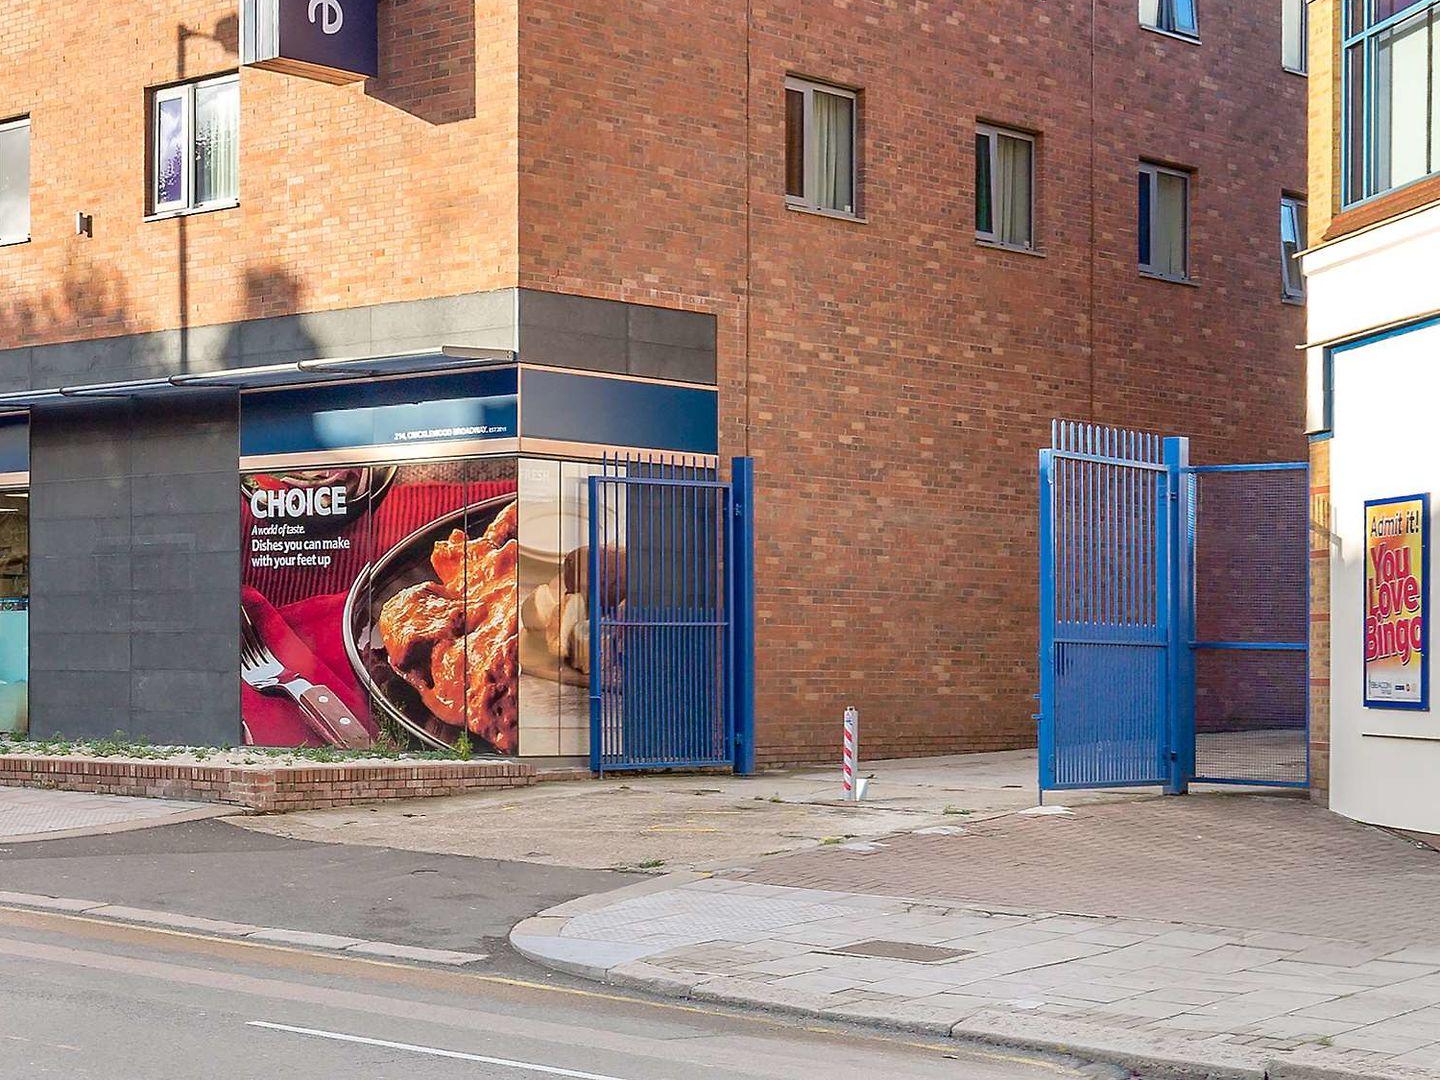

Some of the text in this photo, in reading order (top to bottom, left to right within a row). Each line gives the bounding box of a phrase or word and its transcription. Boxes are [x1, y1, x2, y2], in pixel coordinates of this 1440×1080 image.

[250, 486, 348, 519] CHOICE
[278, 524, 287, 537] of
[287, 525, 306, 534] taste.
[1371, 510, 1420, 537] Admit it!
[252, 537, 350, 554] Dishes you can make
[251, 554, 331, 569] with your feet up
[1370, 542, 1412, 587] You
[1368, 575, 1420, 618] Love
[1366, 615, 1422, 667] Bingo
